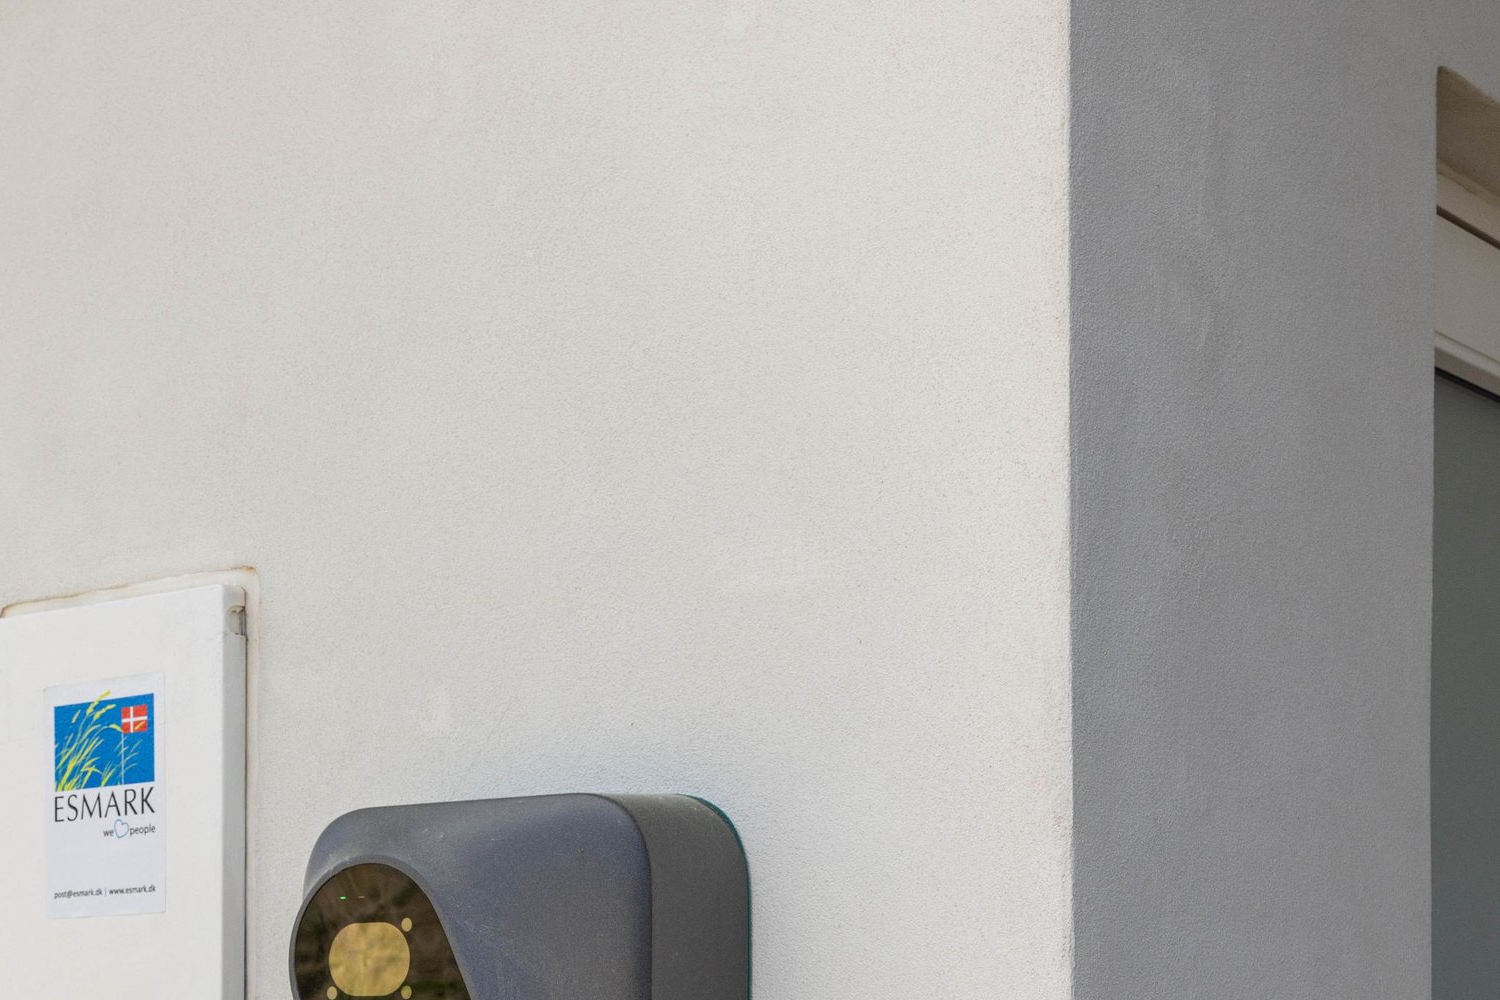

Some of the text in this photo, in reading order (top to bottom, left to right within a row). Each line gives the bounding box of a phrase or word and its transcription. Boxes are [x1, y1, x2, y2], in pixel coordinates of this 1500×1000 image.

[54, 786, 155, 822] ESMARK
[103, 824, 156, 837] we people
[54, 884, 156, 899] post@esmark.dk www.esmark.dk
